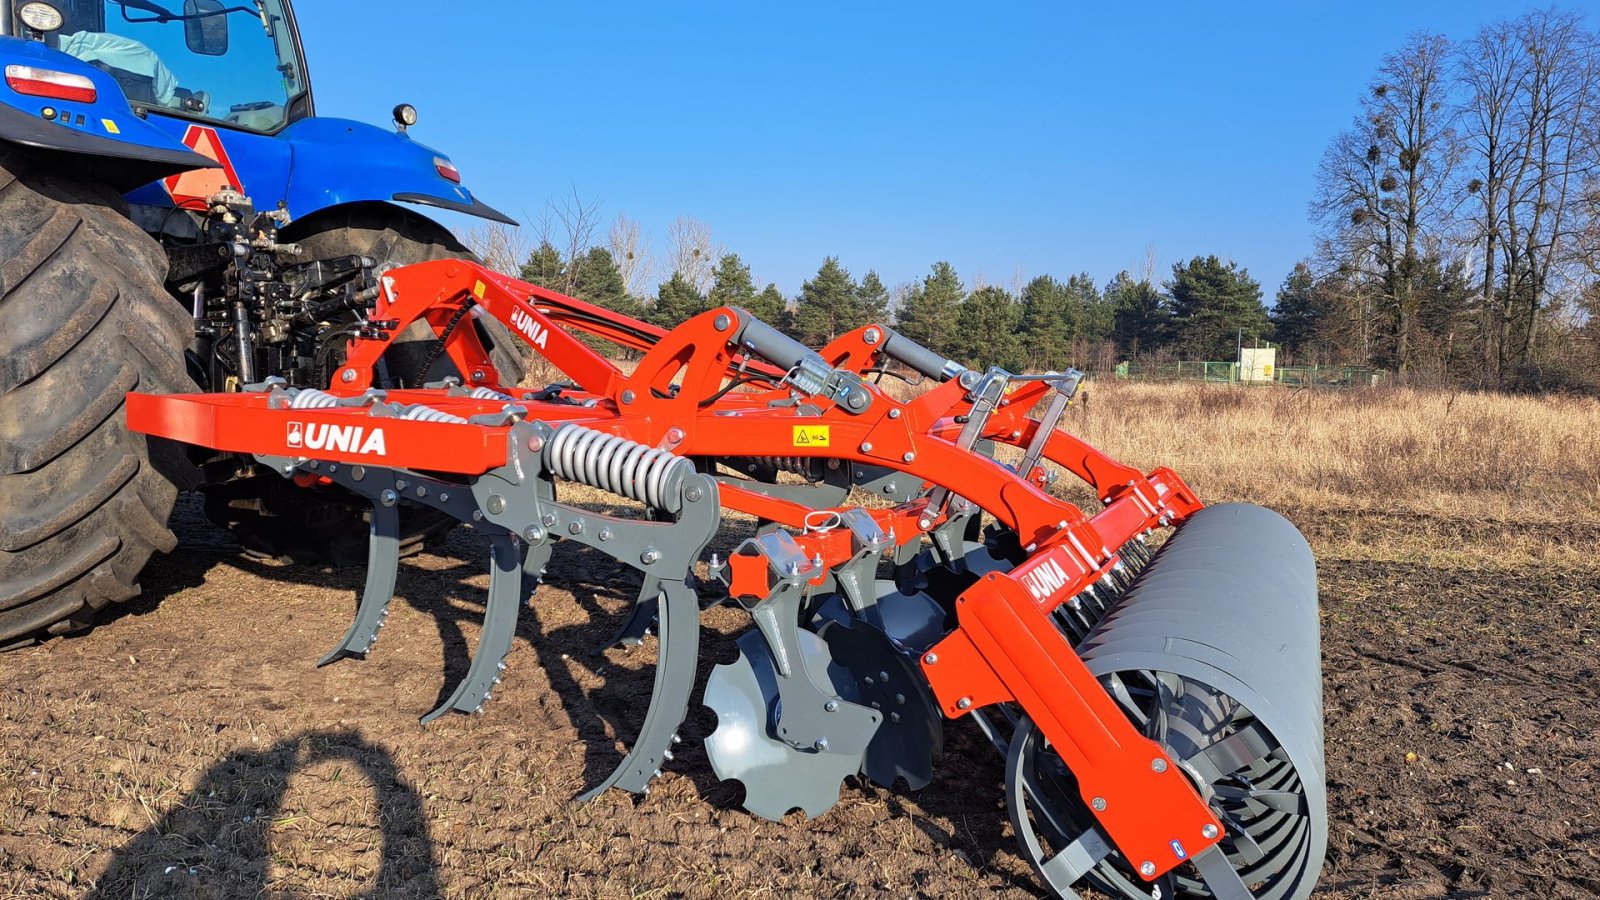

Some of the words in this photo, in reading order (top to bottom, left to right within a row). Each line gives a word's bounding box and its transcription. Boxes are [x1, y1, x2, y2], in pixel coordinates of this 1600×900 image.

[516, 310, 549, 350] UNIA
[304, 422, 386, 456] UNIA
[1028, 557, 1071, 598] UNIA
